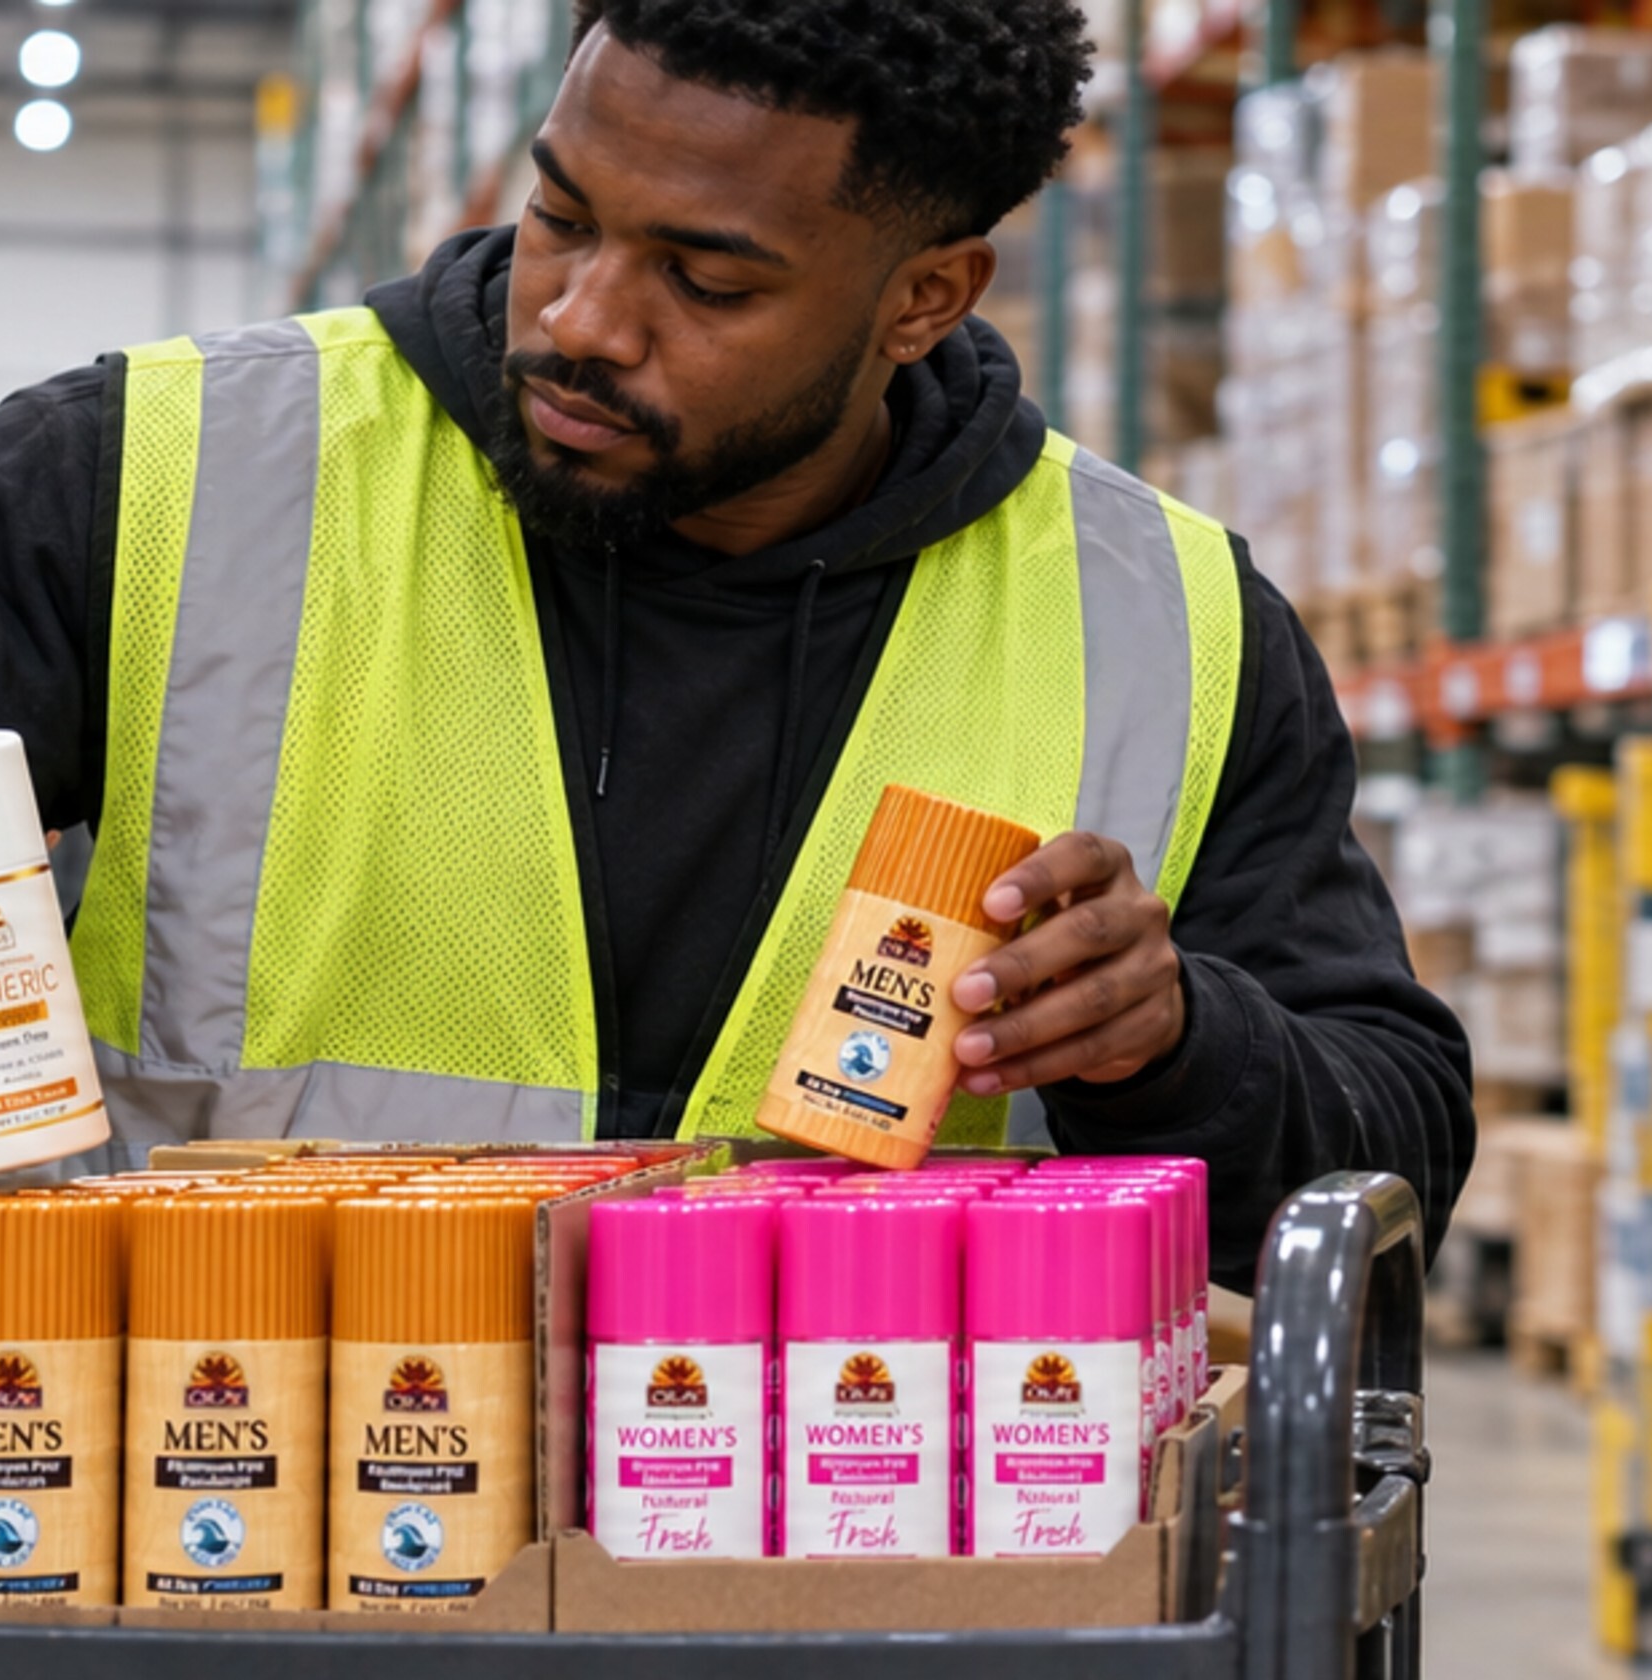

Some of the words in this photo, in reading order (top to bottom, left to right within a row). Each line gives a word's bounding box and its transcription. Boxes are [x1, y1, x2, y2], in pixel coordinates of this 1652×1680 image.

[848, 959, 935, 1008] MEN'S
[164, 1420, 268, 1451] MEN'S
[365, 1424, 468, 1456] MEN'S
[617, 1426, 737, 1448] WOMEN'S
[805, 1423, 924, 1446] WOMEN'S
[991, 1422, 1110, 1446] WOMEN'S
